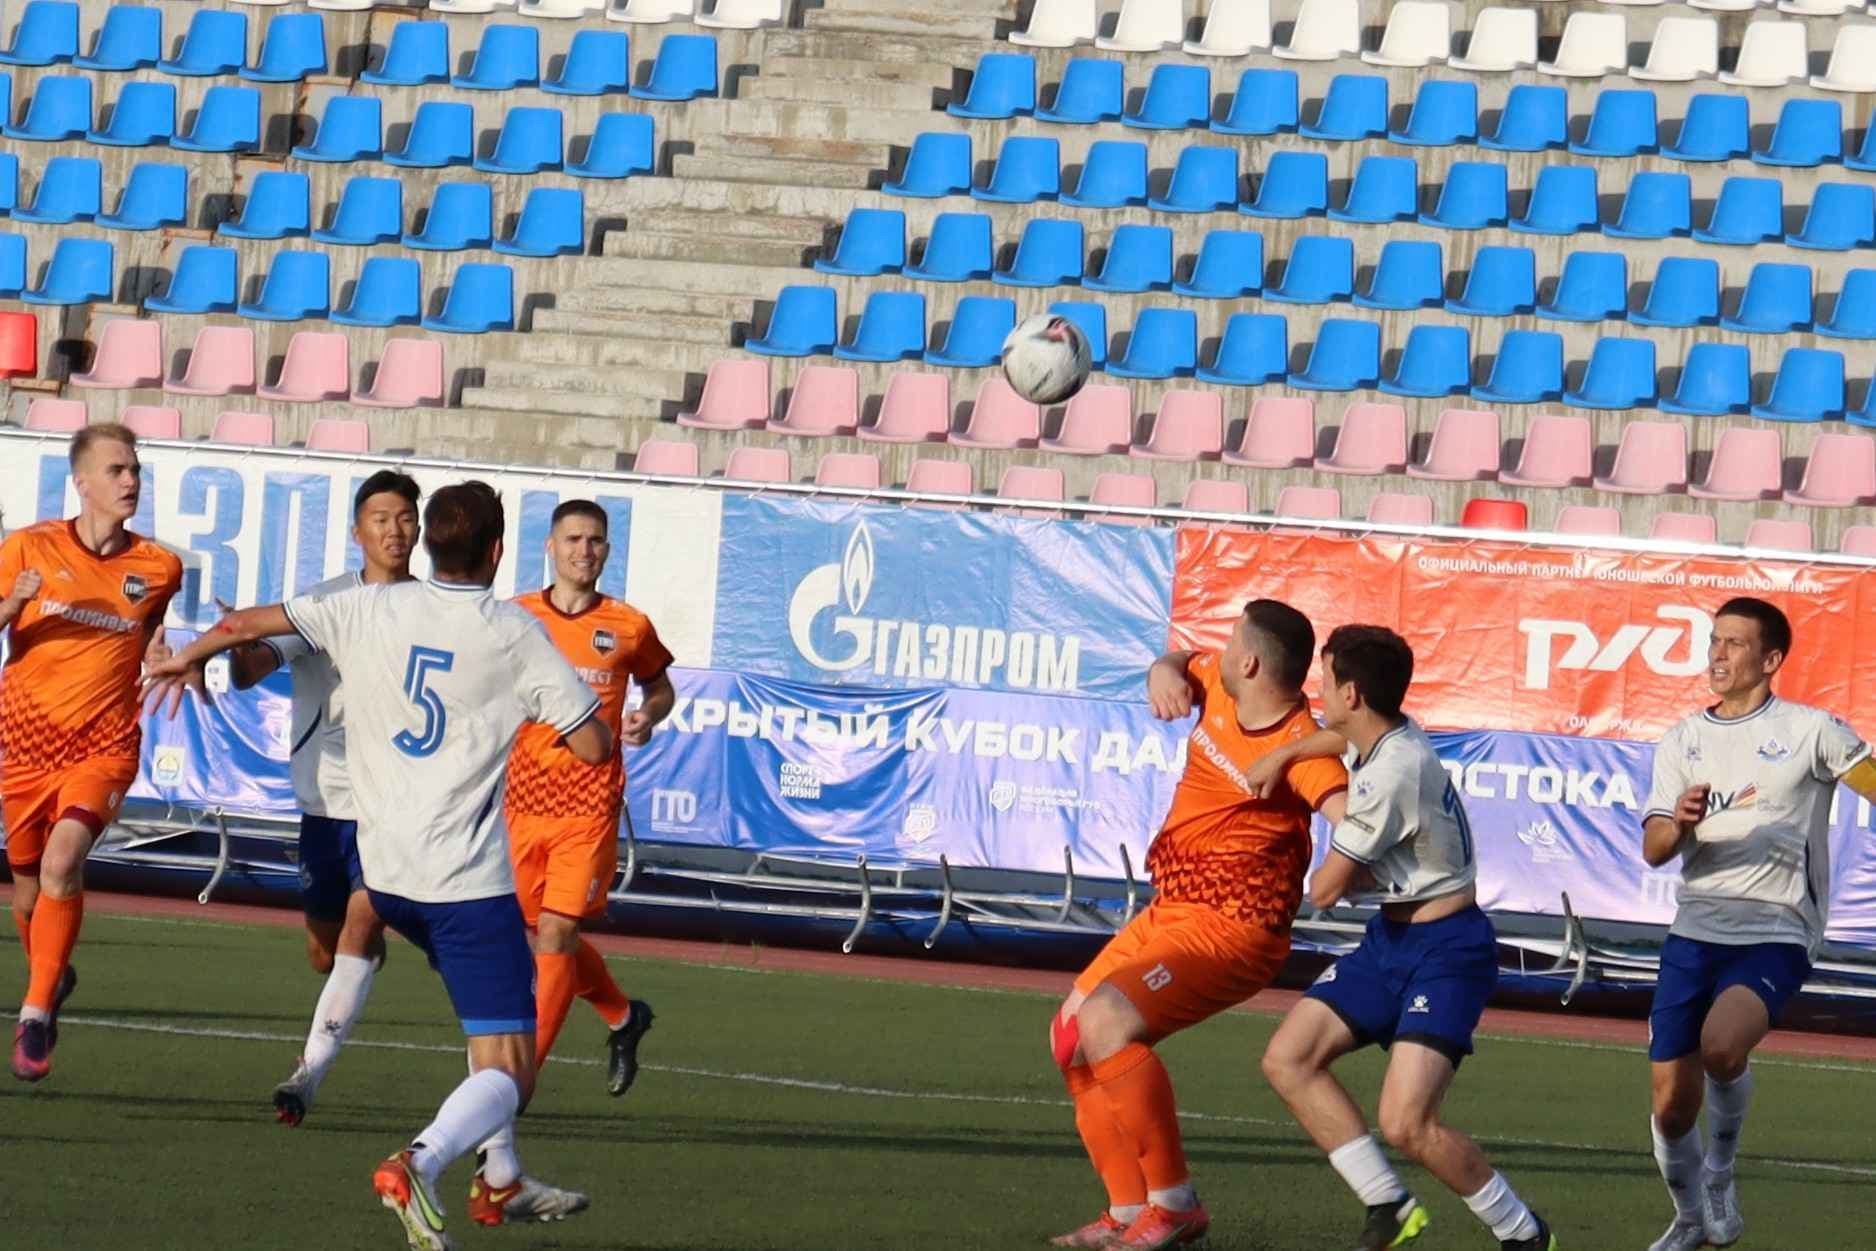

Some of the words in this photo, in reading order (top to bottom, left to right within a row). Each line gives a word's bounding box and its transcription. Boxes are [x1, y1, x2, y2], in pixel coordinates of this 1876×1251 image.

[1418, 556, 1527, 577] ОФИЦИАЛЬНЫЙ
[1531, 564, 1590, 579] ПАРТНЕ
[873, 618, 1081, 691] ГАЗПРОМ
[391, 644, 455, 759] 5
[904, 706, 1080, 764] КУБОК
[651, 788, 698, 823] ГТО
[1142, 962, 1173, 993] 13
